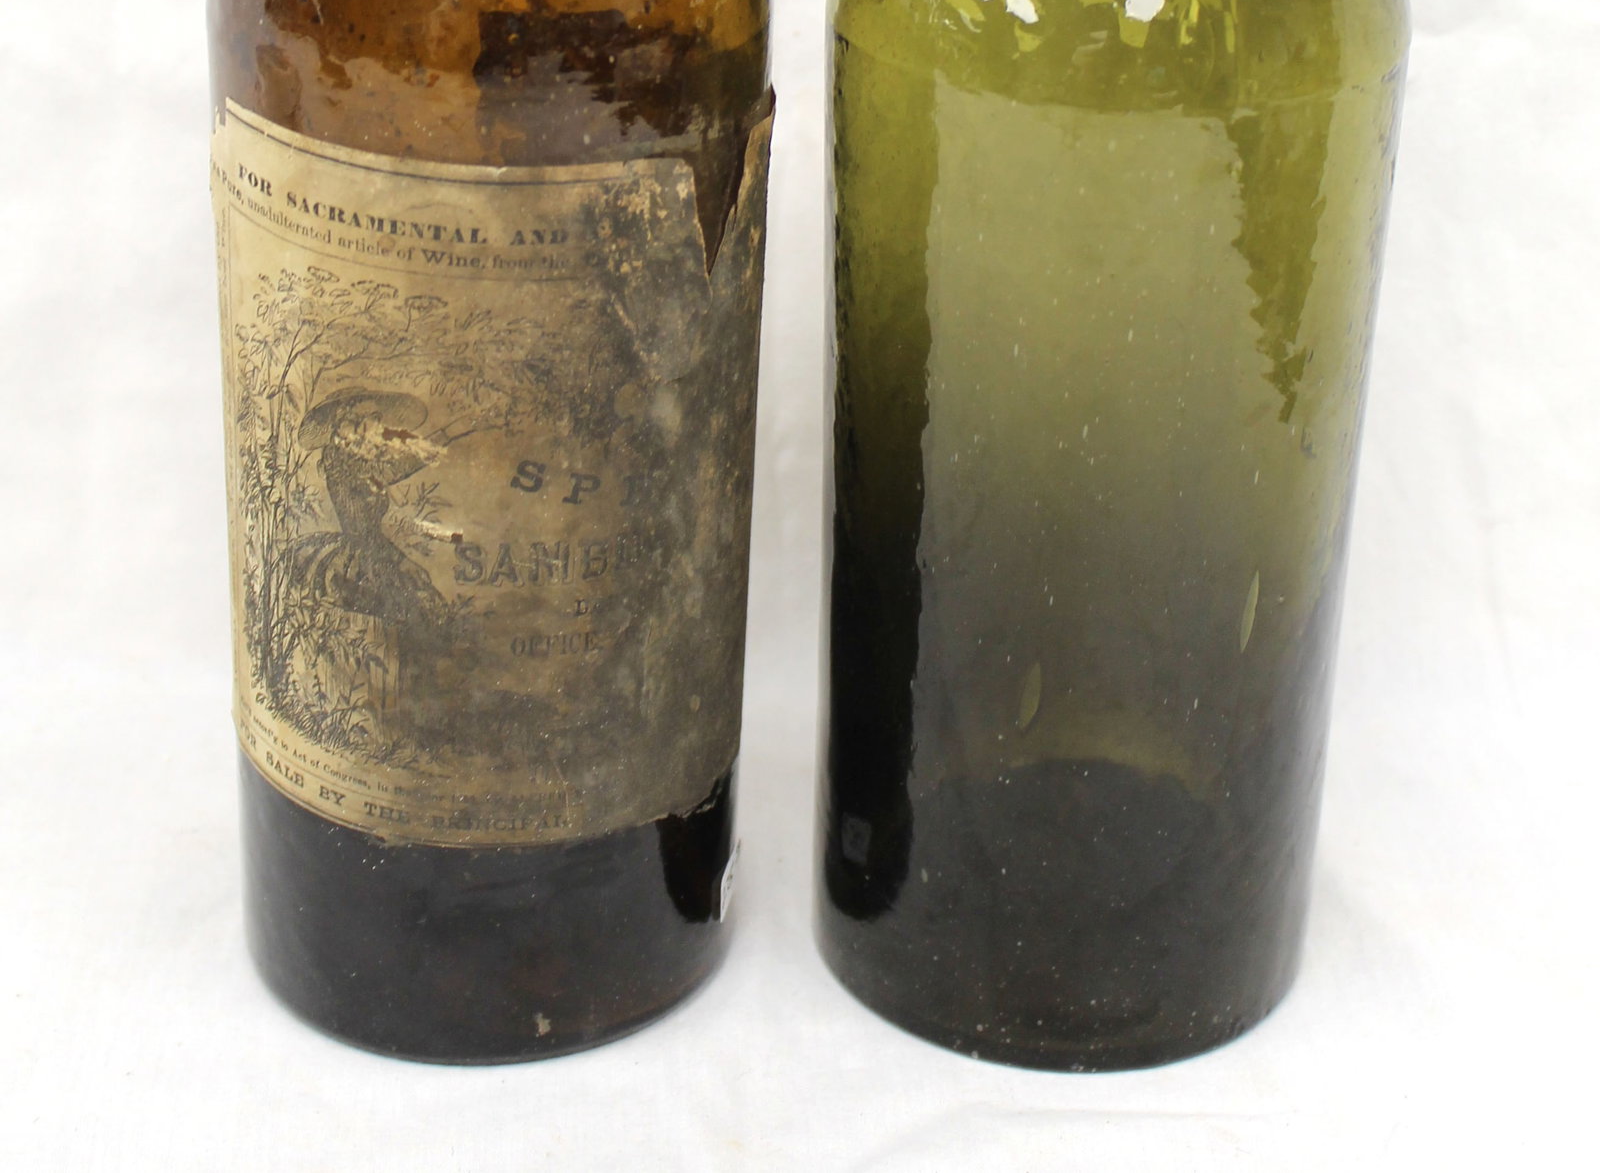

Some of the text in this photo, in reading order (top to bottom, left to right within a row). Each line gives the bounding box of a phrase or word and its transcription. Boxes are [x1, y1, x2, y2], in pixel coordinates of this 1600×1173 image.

[238, 163, 273, 197] FOR
[286, 190, 488, 245] SACRAMENTAL
[509, 228, 570, 246] AND
[247, 197, 331, 244] unadulterated
[337, 236, 390, 256] article
[396, 246, 416, 261] of
[420, 248, 487, 270] Wine,
[492, 254, 535, 270] from
[265, 750, 305, 789] SALE
[319, 785, 347, 807] BY
[363, 801, 411, 825] THE
